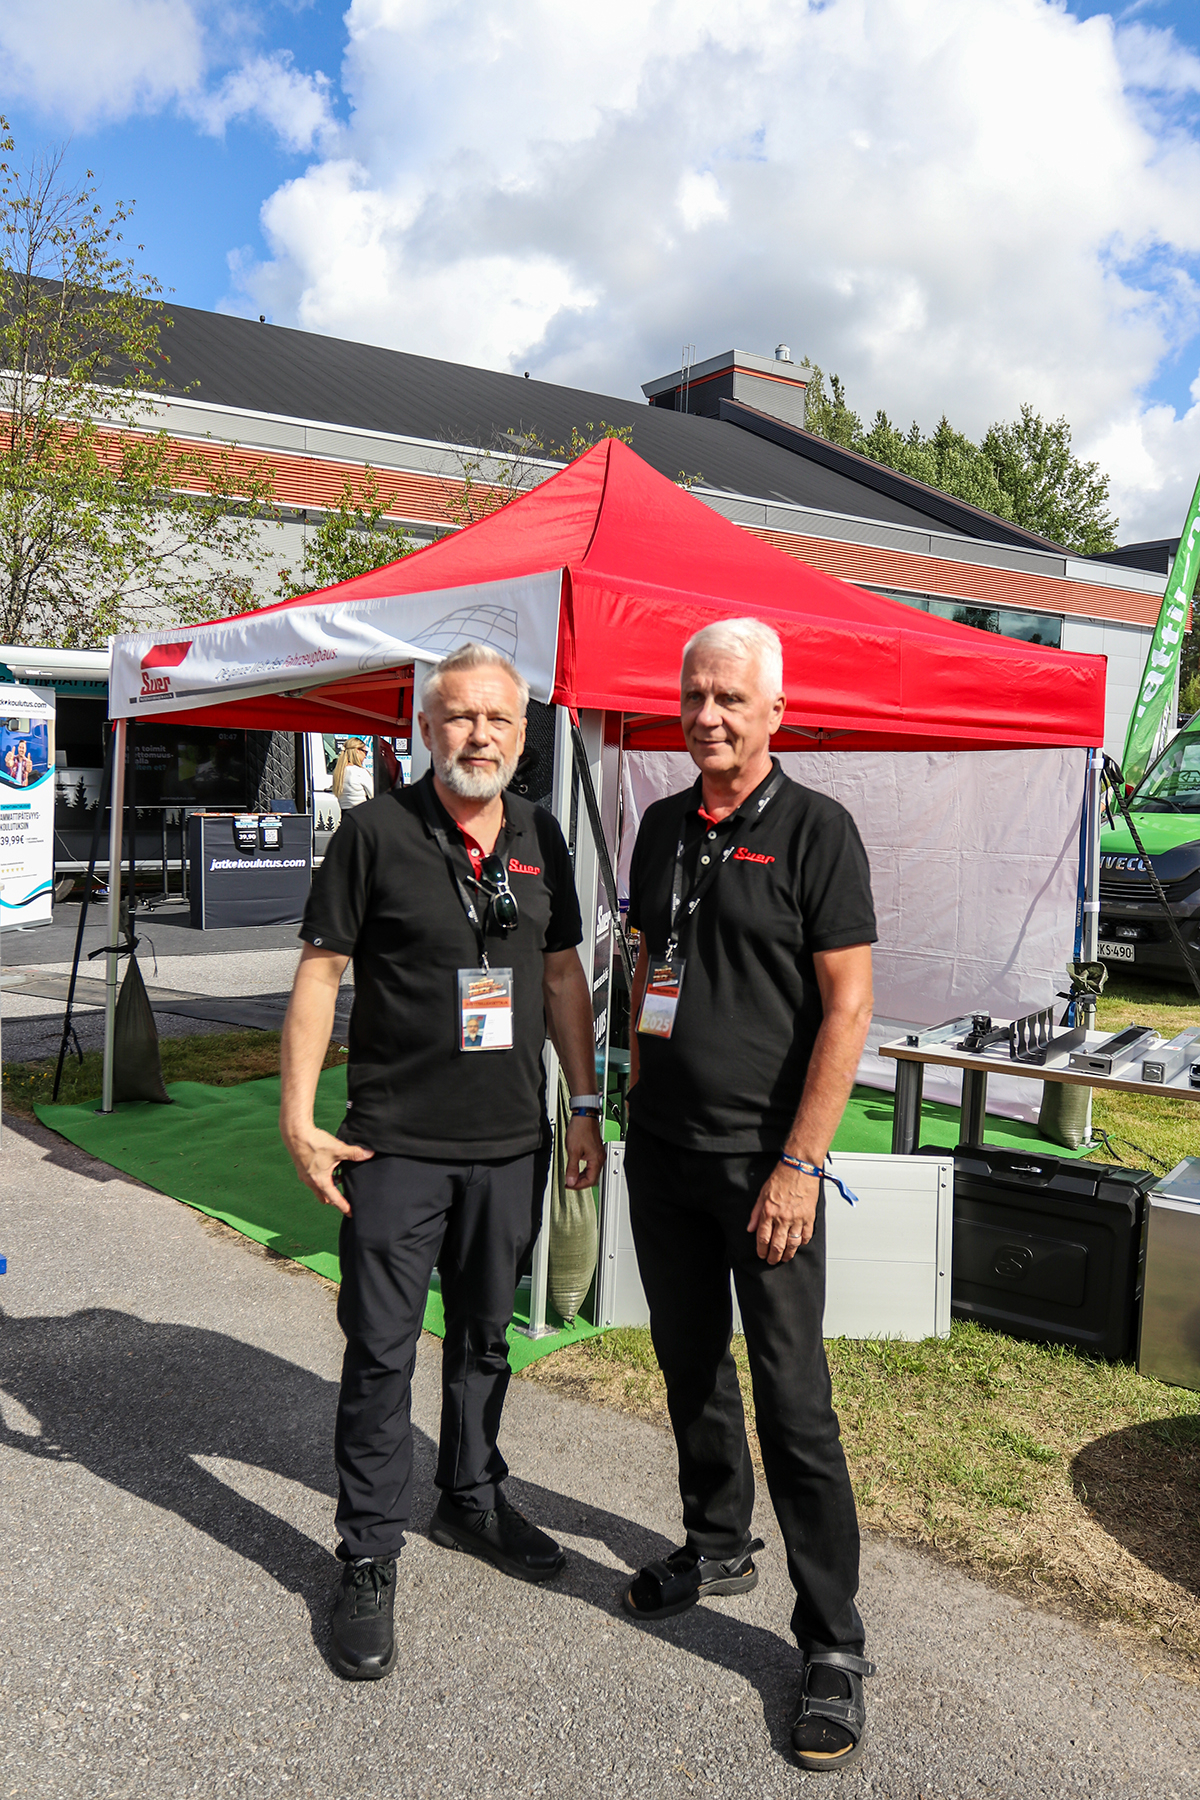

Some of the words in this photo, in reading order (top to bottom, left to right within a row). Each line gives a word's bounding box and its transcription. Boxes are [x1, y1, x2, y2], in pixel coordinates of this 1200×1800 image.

[141, 671, 171, 696] Suer
[141, 744, 166, 752] toimit
[0, 834, 25, 847] 39,99€
[733, 846, 776, 865] Suer
[508, 857, 541, 876] Suer
[1097, 943, 1134, 959] KS-490
[642, 1014, 671, 1033] 2025
